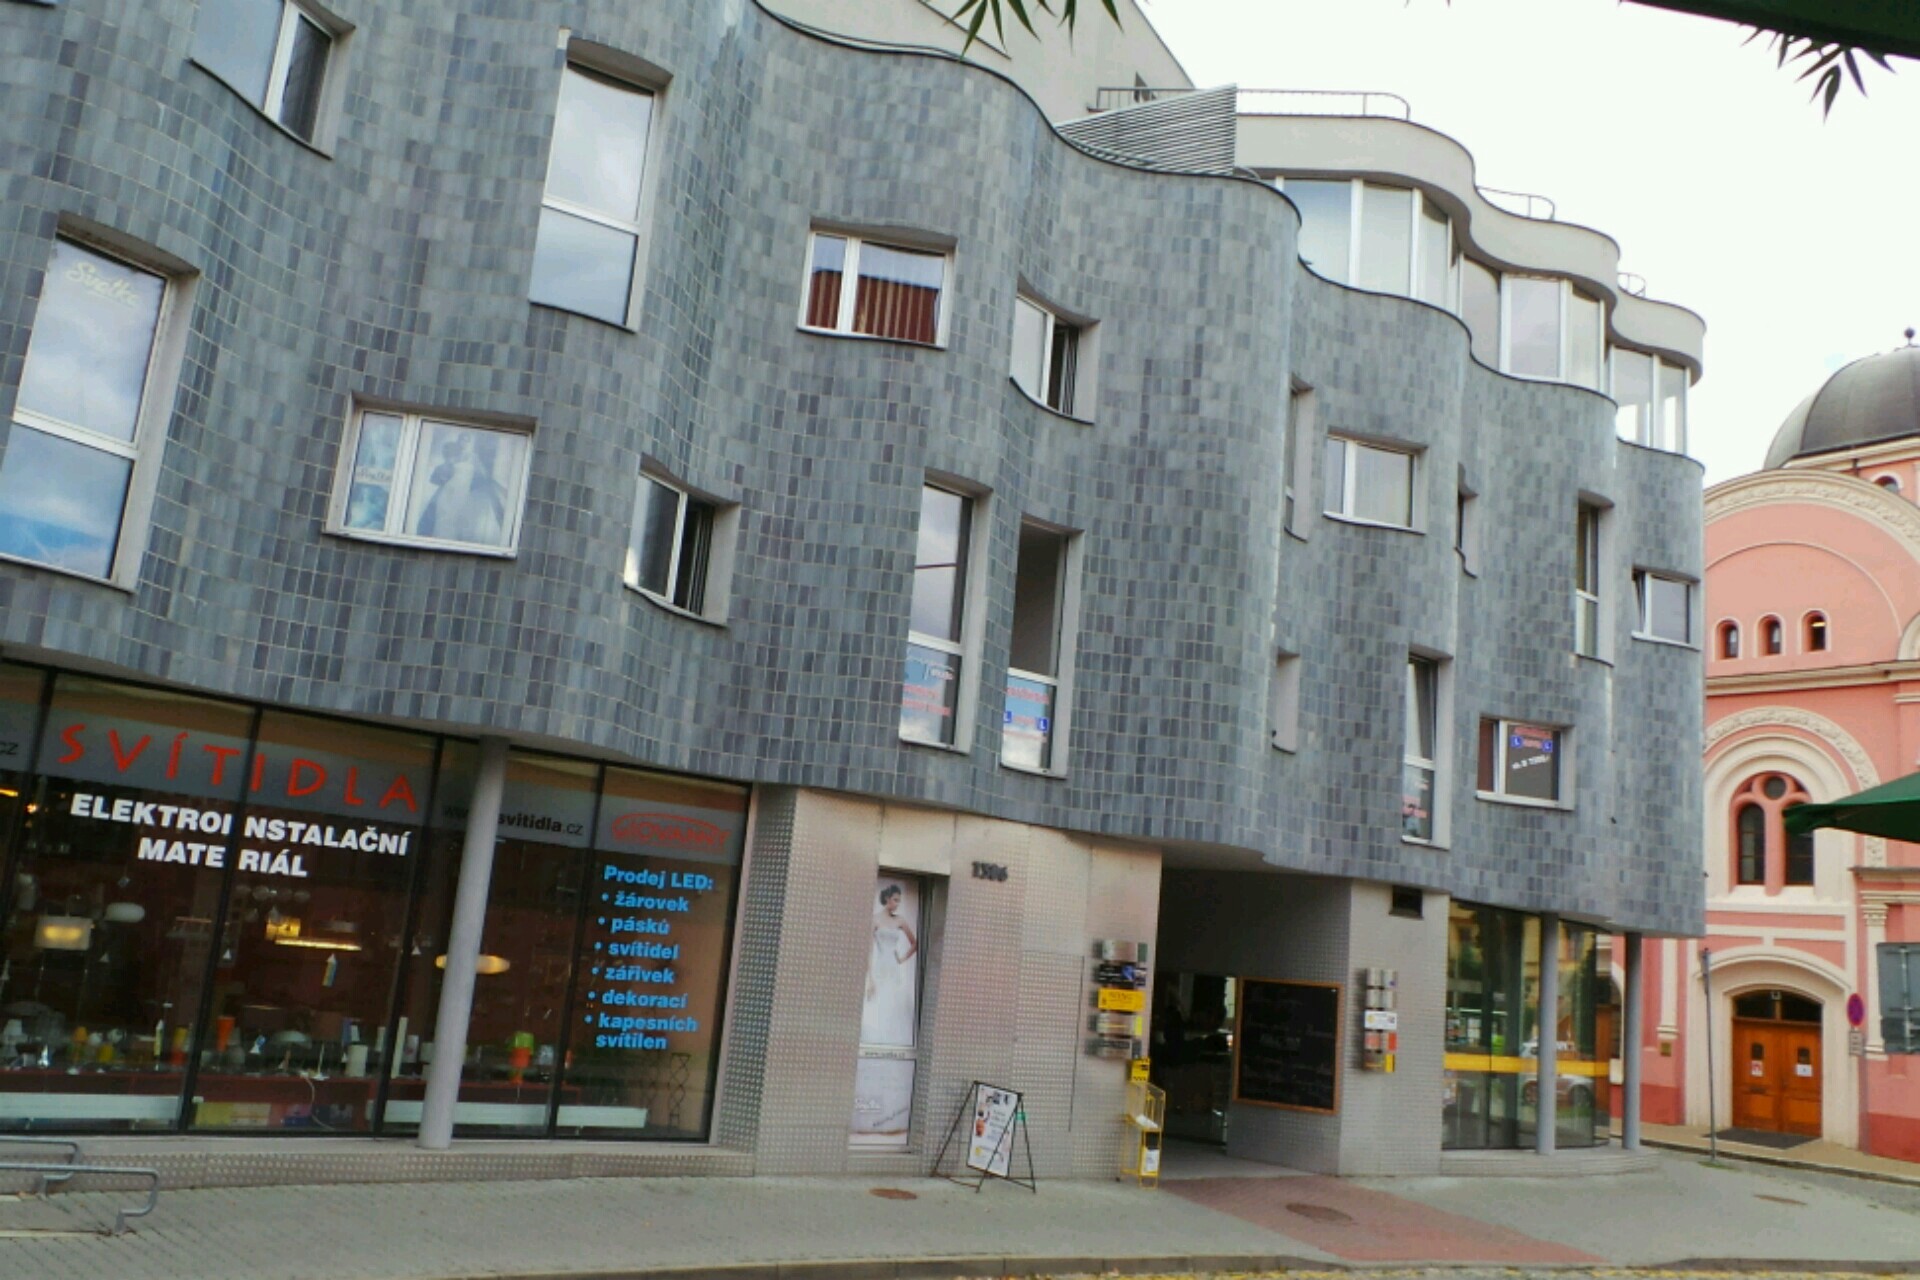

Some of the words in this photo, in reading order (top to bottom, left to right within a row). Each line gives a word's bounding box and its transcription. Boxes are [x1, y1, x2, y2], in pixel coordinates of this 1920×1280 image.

[59, 725, 418, 811] SVÍTIDLA
[604, 865, 666, 888] Prodej
[672, 873, 714, 890] LED:
[614, 891, 689, 912] žárovek
[608, 942, 680, 960] svítidel
[604, 966, 675, 983] zářivek
[602, 990, 688, 1009] dekorací
[598, 1012, 698, 1032] kapesních
[596, 1032, 668, 1049] svítilen
